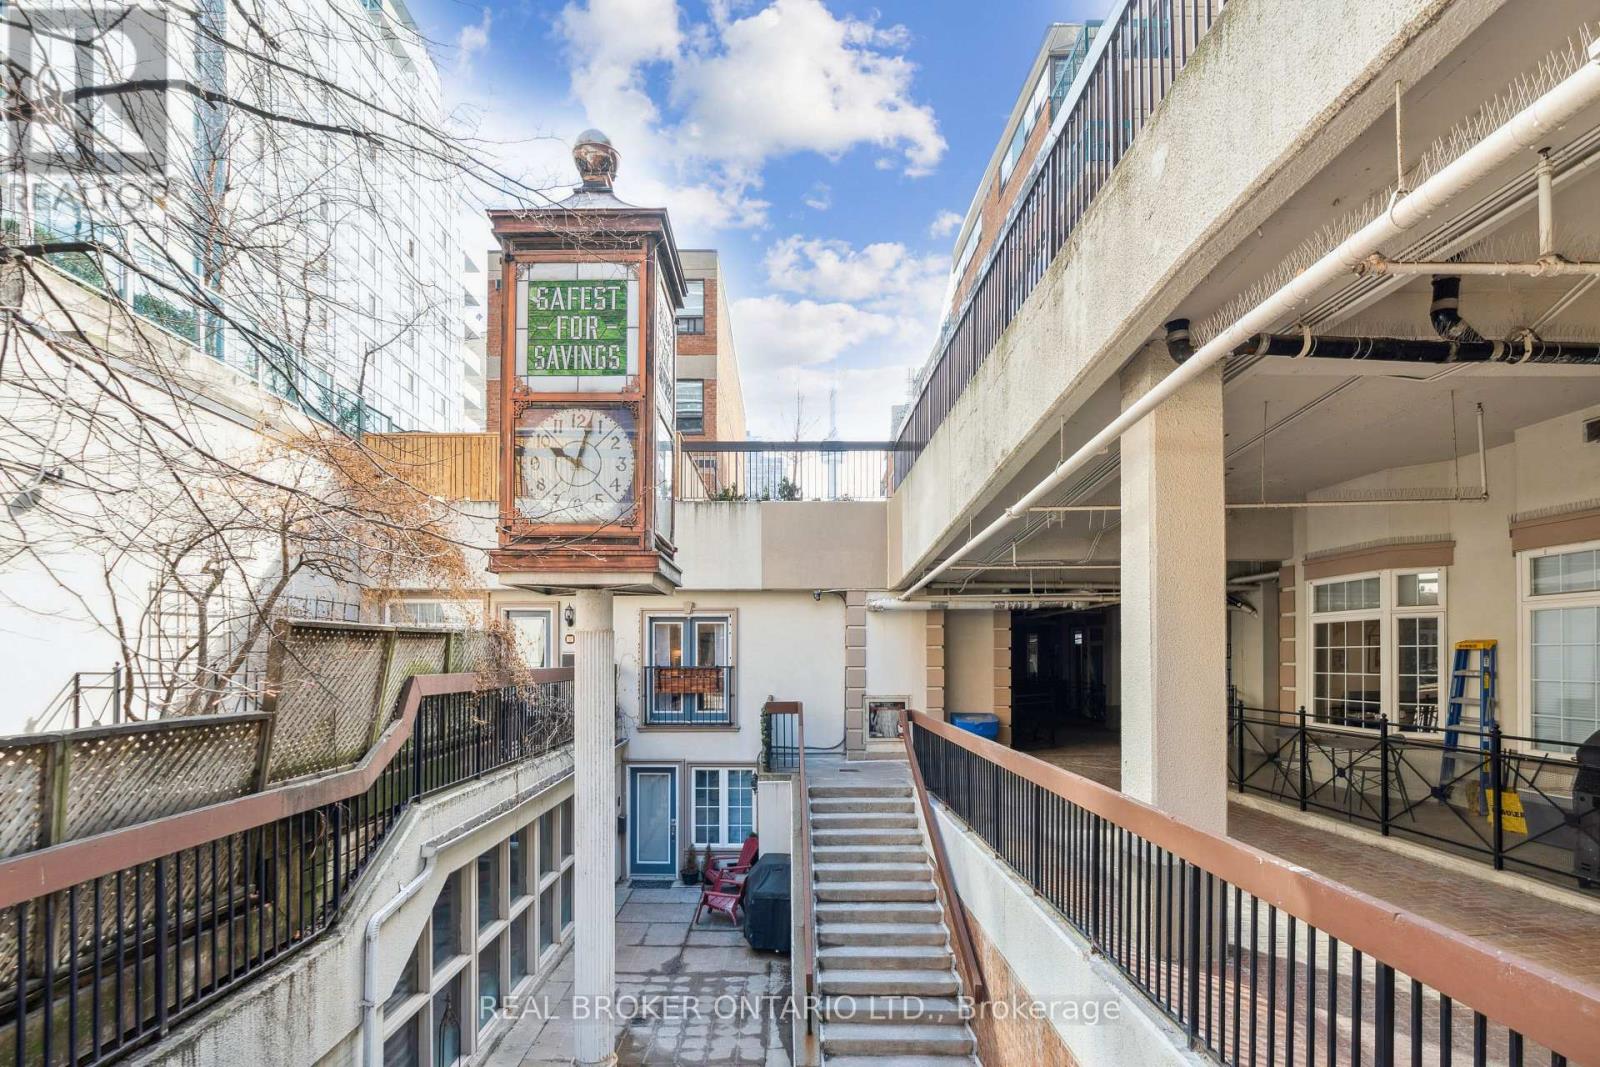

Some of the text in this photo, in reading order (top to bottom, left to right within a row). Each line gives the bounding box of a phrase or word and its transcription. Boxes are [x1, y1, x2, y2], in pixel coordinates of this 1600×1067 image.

[536, 286, 621, 310] SAFEST
[556, 315, 598, 339] FOR
[534, 345, 620, 370] SAVINGS
[571, 413, 586, 428] 12
[536, 433, 551, 447] 10
[610, 435, 621, 450] 2
[530, 455, 541, 471] 9
[615, 456, 627, 472] 3
[536, 477, 546, 491] 8
[609, 477, 621, 492] 4
[594, 493, 604, 509] 5
